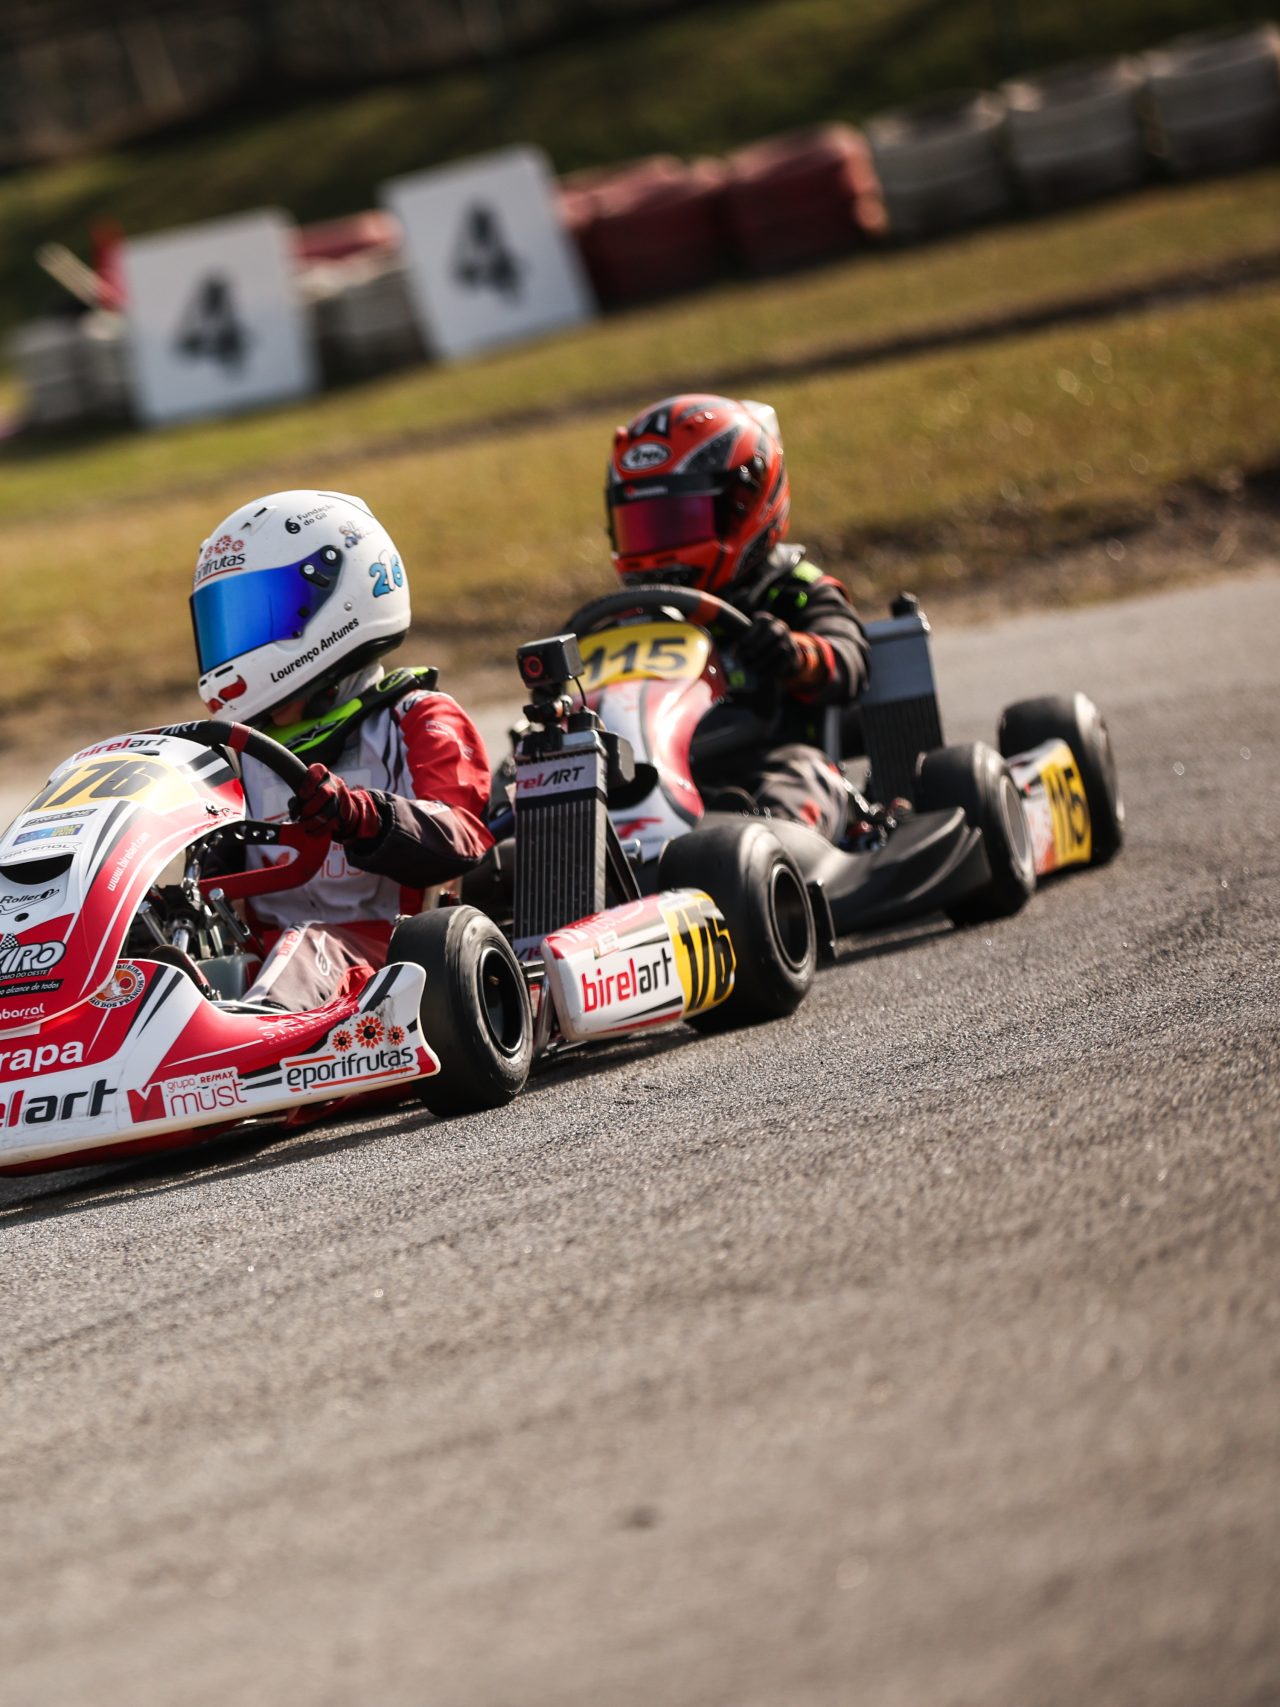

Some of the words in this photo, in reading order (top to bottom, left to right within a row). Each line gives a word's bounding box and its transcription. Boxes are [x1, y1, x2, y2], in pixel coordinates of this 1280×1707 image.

[453, 198, 523, 305] 4
[175, 270, 248, 378] 4
[270, 647, 320, 683] Lourenço
[320, 618, 360, 651] Antunes
[582, 636, 687, 681] 115
[74, 738, 171, 761] birelart
[28, 760, 168, 812] 176
[6, 984, 29, 995] alcance
[31, 982, 40, 990] de
[41, 981, 60, 989] todos
[27, 969, 49, 977] OESTE
[581, 946, 672, 1013] birelart
[167, 1078, 196, 1094] grupo
[200, 1071, 234, 1084] RE/MAX
[286, 1045, 415, 1090] eporifrutas
